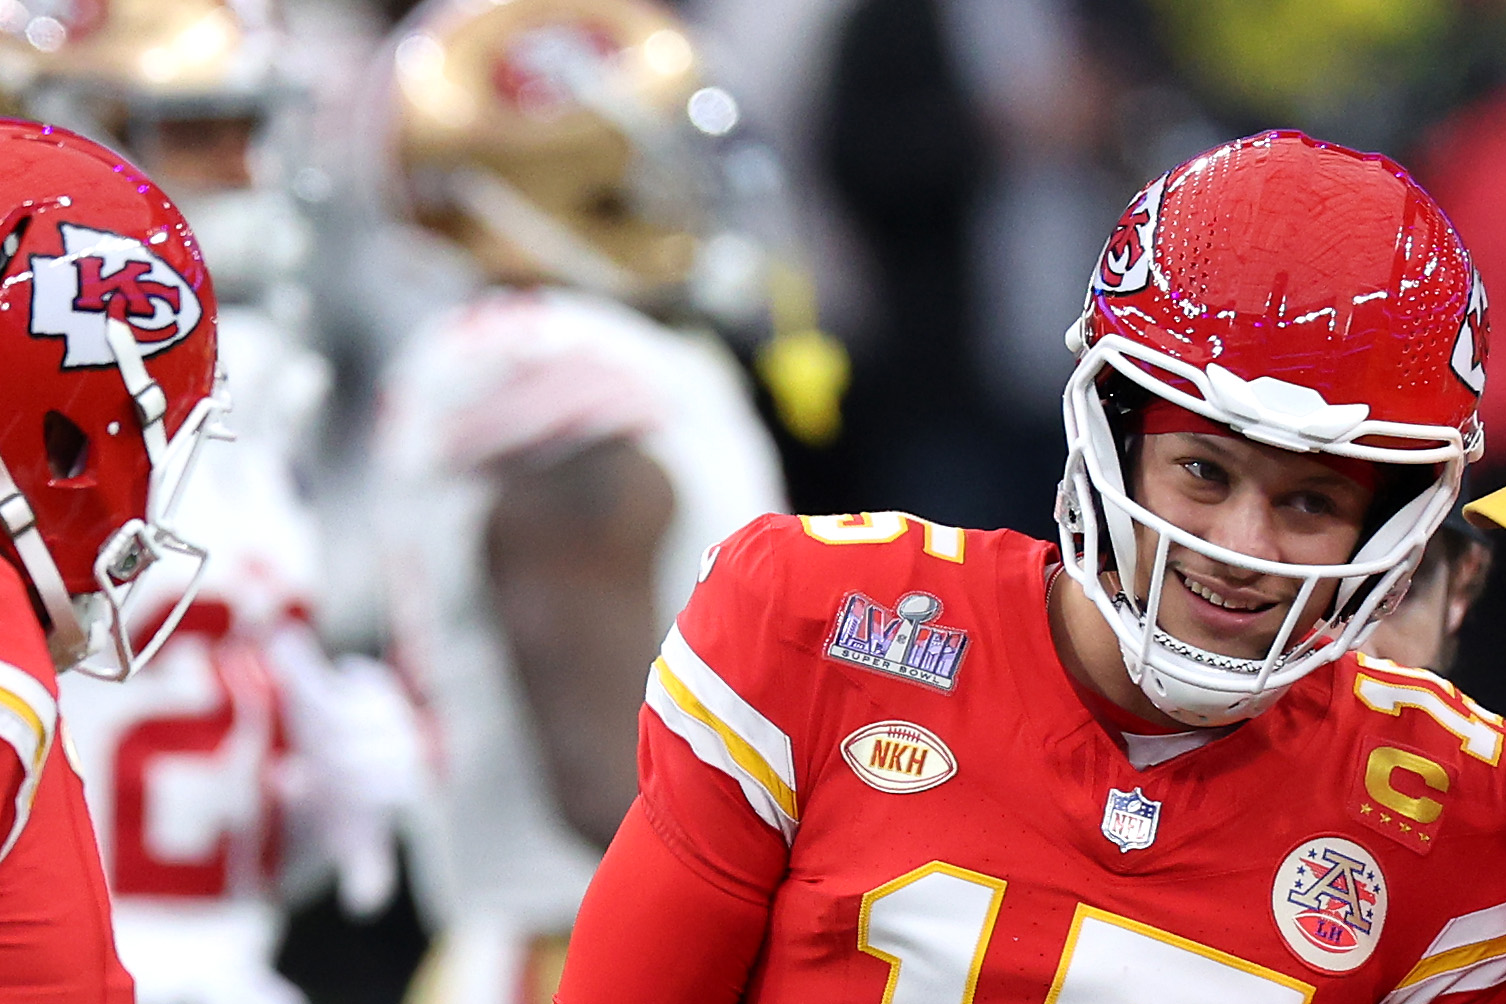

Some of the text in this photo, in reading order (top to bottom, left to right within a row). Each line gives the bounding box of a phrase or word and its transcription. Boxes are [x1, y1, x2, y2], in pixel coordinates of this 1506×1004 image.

[73, 255, 181, 344] KC
[841, 649, 941, 685] SUPER BOWL
[869, 739, 928, 777] NKH
[1365, 746, 1450, 824] C
[1112, 811, 1146, 841] NFL
[1287, 847, 1372, 936] A
[1315, 920, 1344, 944] LH
